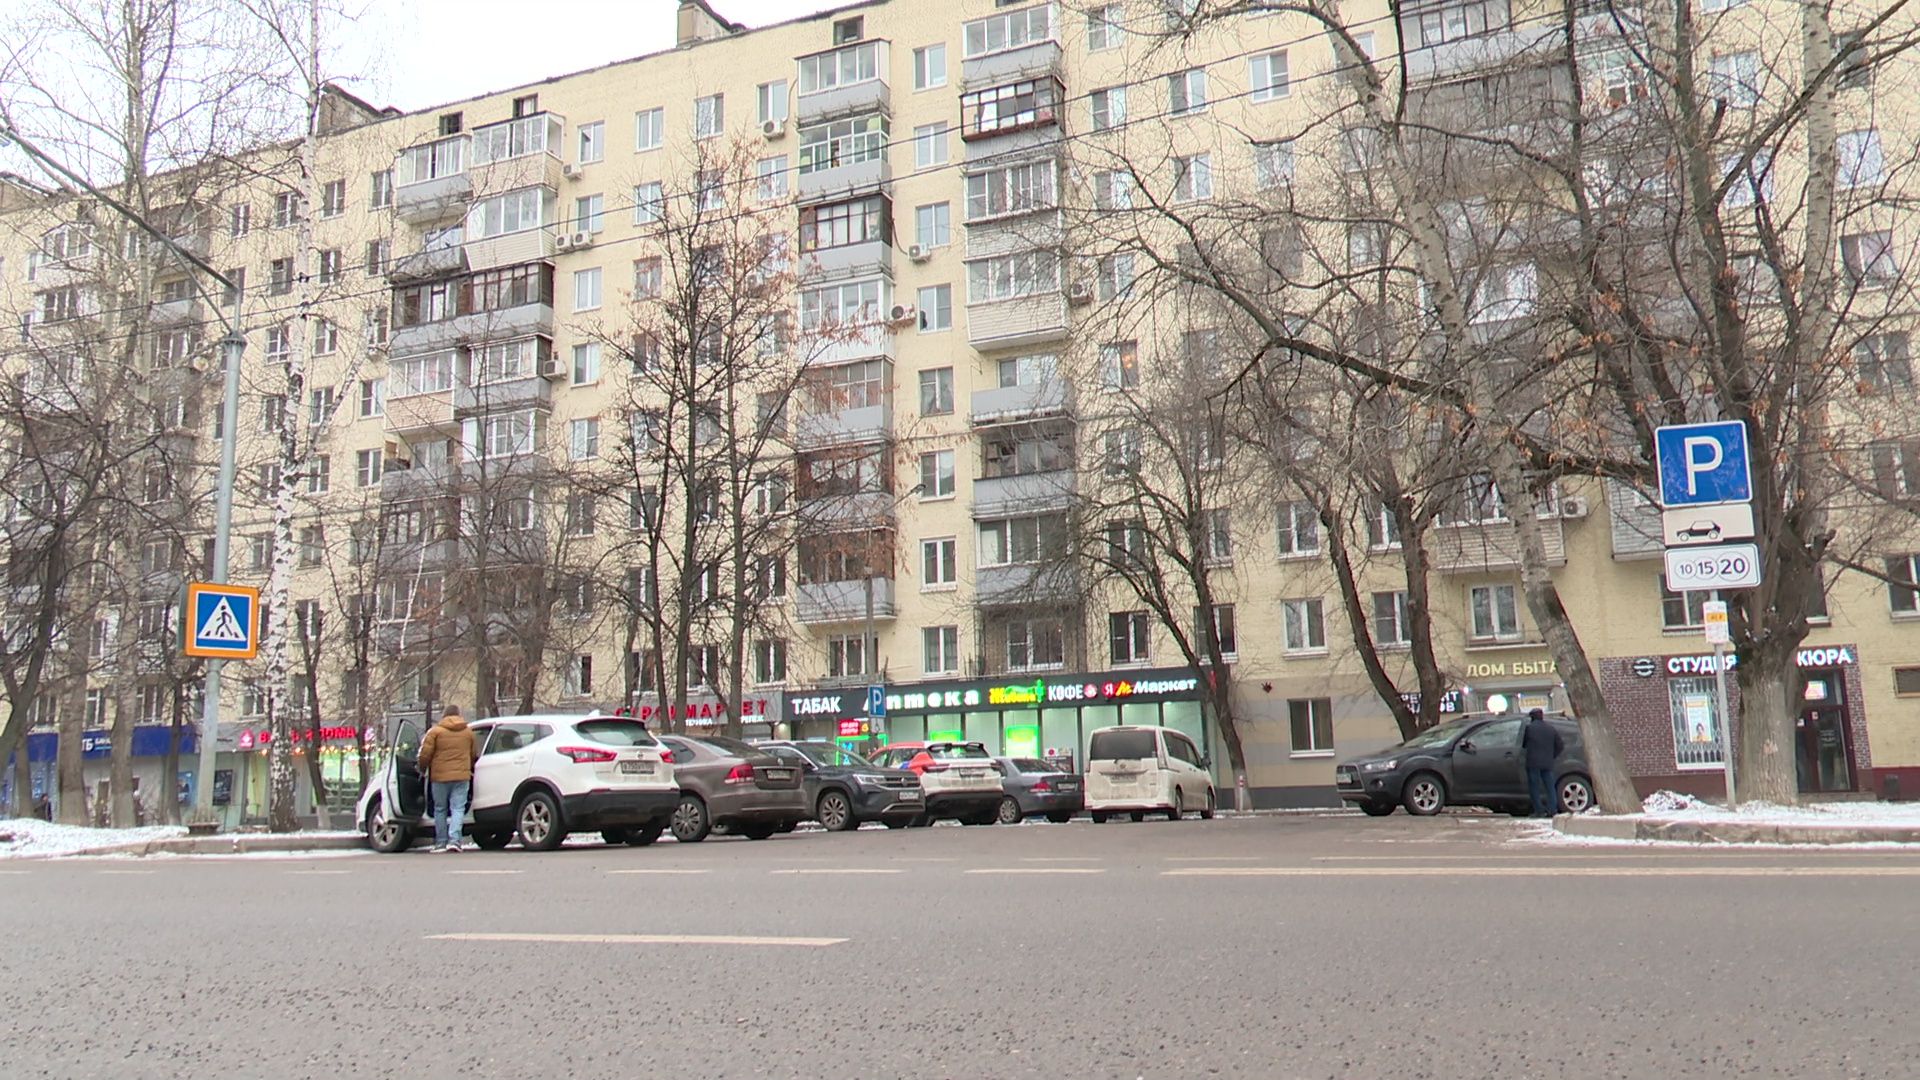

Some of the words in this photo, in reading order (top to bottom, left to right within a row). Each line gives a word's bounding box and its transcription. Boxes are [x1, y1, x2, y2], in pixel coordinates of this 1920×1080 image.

[1684, 435, 1724, 496] P
[1679, 564, 1693, 575] 10
[1698, 561, 1713, 575] 15
[1720, 557, 1746, 575] 20
[1797, 648, 1853, 667] КЮРА
[1466, 663, 1505, 678] ДОМ
[1048, 684, 1084, 701] КОФЕ
[1132, 678, 1197, 695] Маркет
[791, 696, 842, 715] ТАБАК
[872, 690, 883, 713] P
